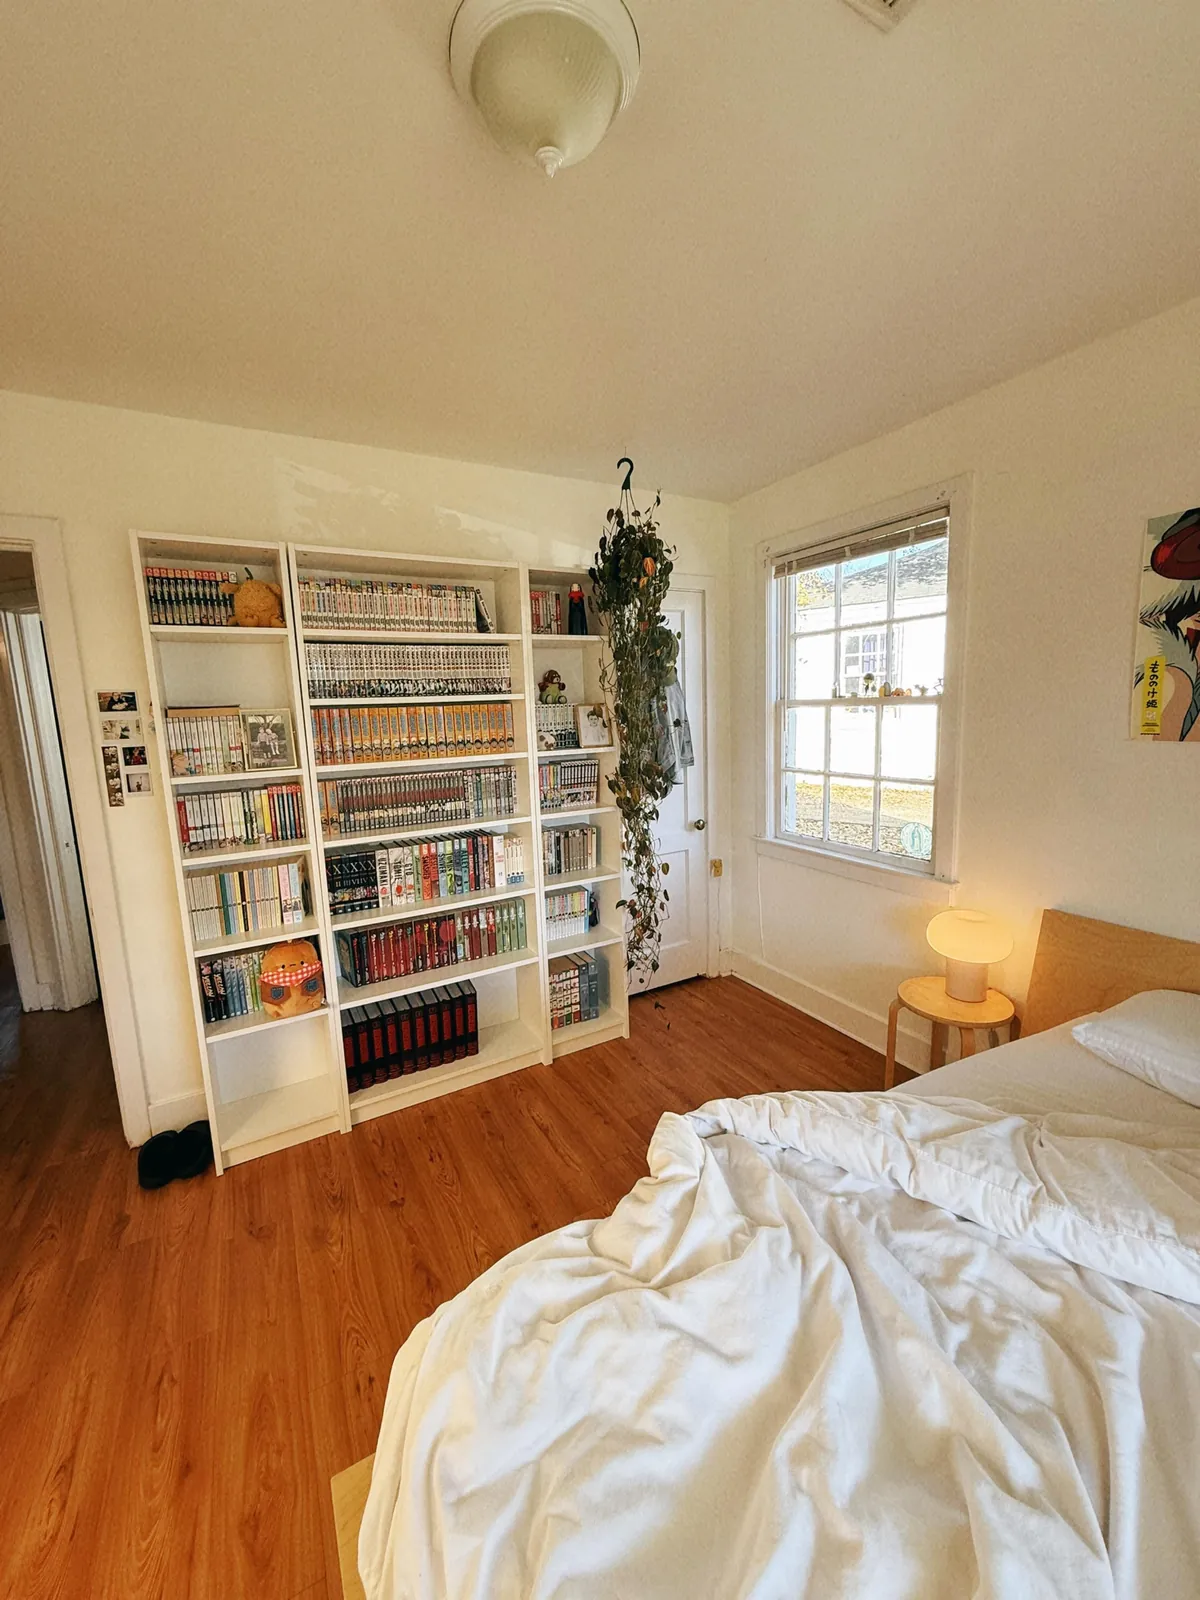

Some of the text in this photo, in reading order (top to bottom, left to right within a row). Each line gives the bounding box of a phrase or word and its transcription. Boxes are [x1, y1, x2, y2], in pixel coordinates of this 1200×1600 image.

[1146, 660, 1160, 709] もののけ姫
[378, 857, 389, 886] UZUMAKI
[394, 860, 403, 880] TOMIE
[404, 863, 414, 876] GYO
[438, 853, 446, 874] SHIVER
